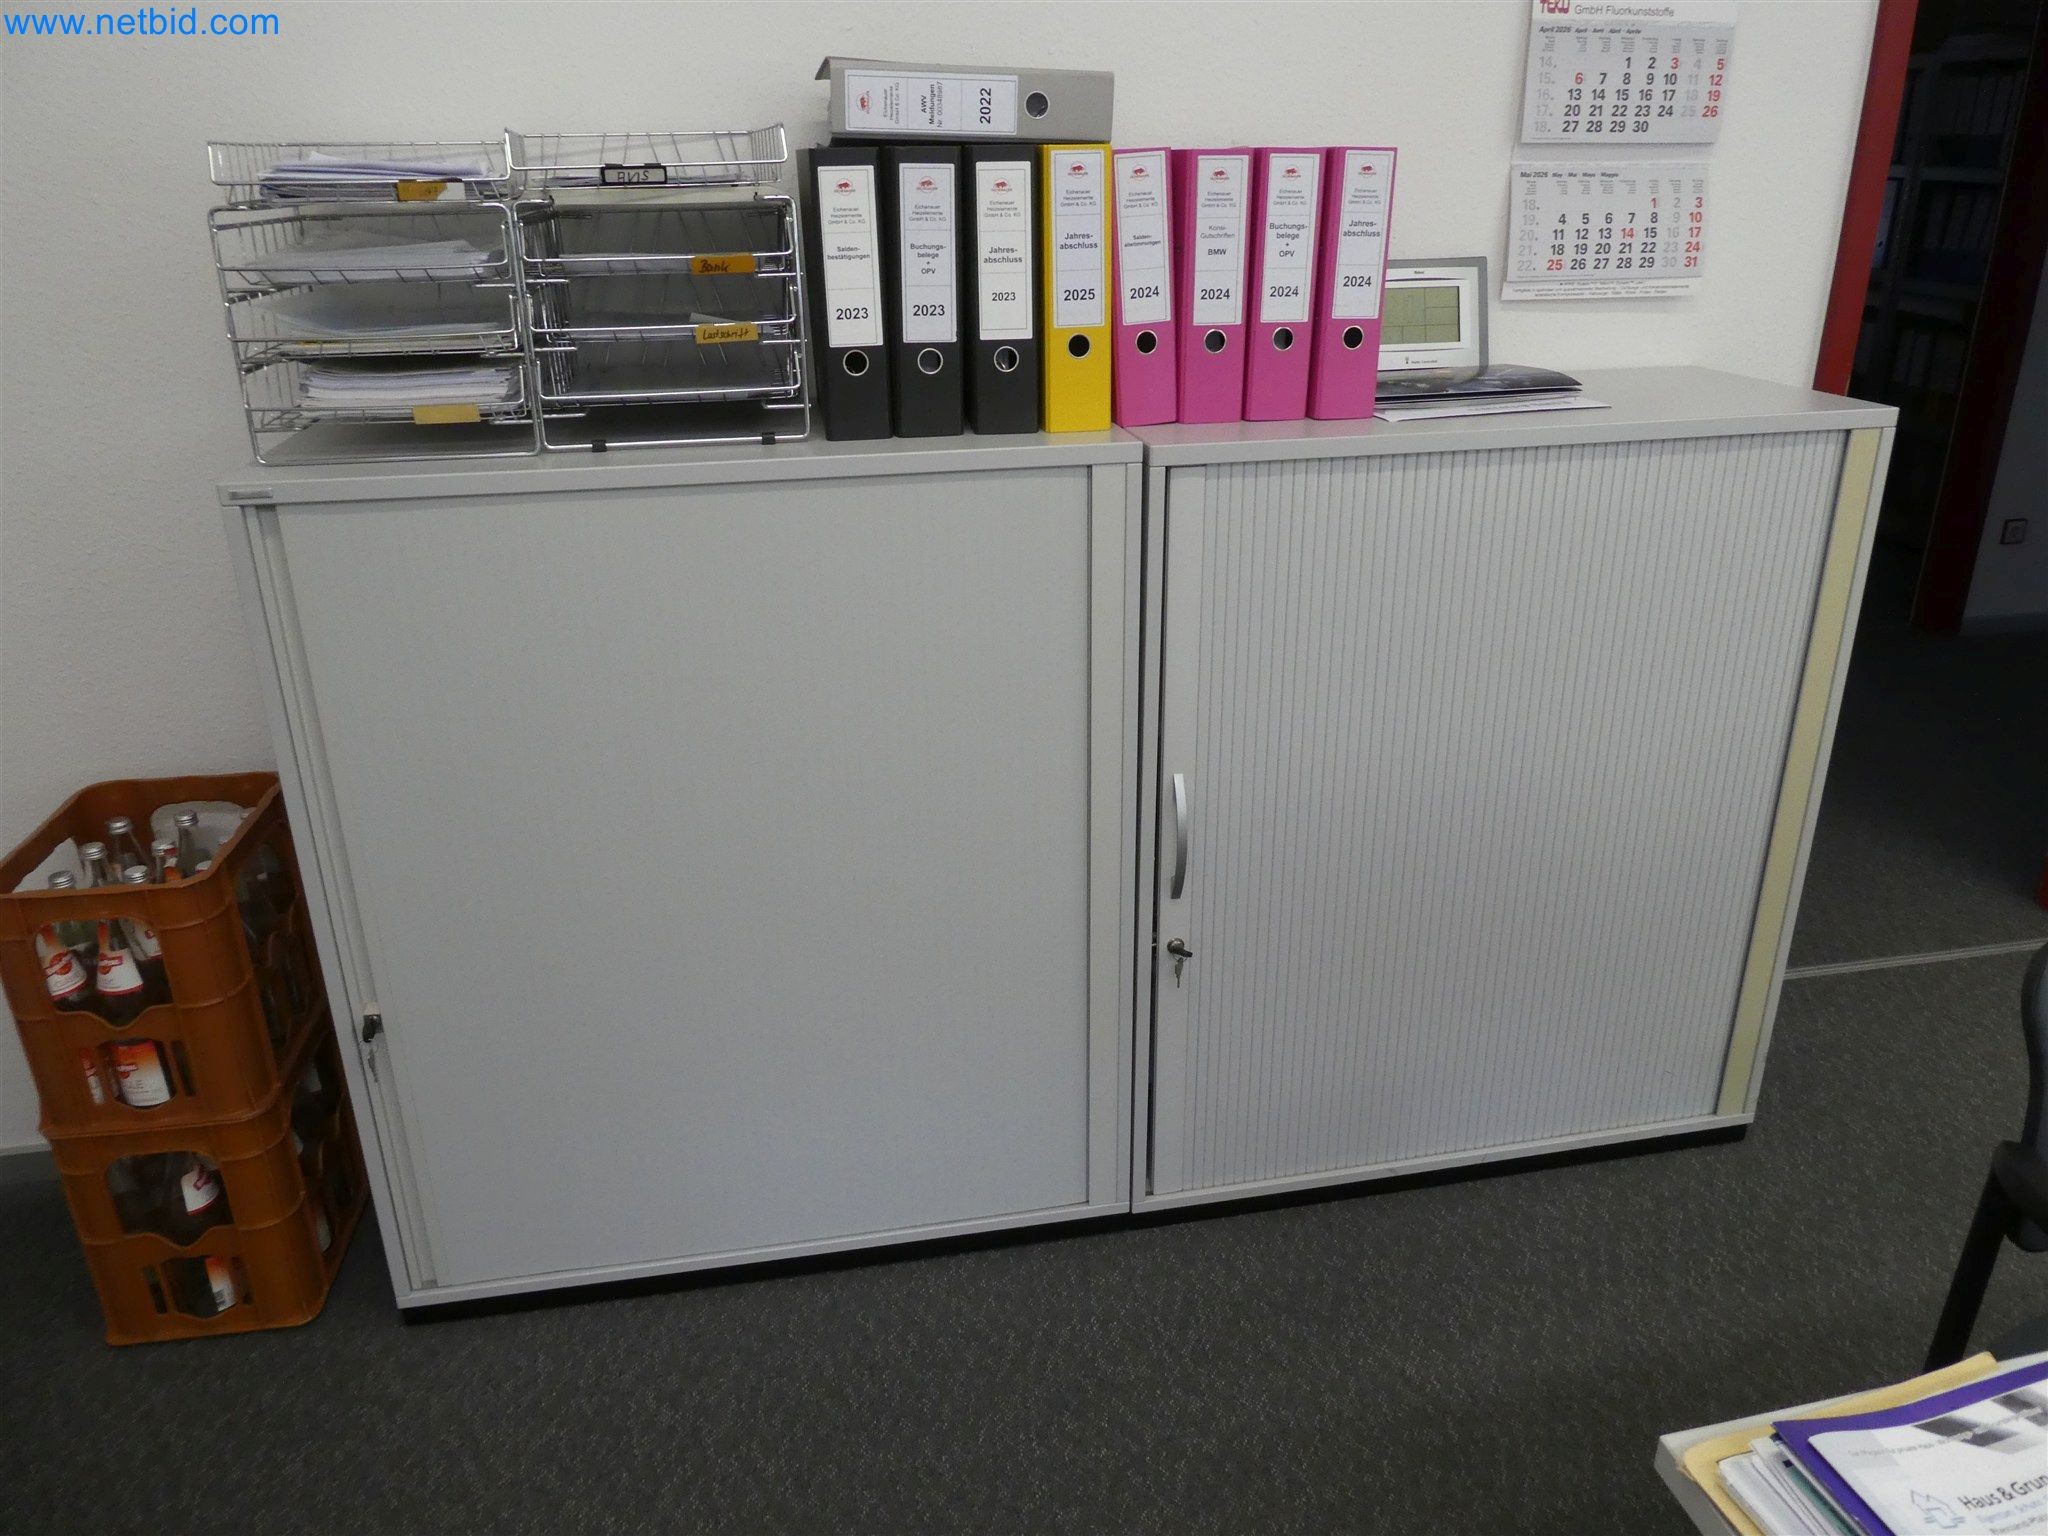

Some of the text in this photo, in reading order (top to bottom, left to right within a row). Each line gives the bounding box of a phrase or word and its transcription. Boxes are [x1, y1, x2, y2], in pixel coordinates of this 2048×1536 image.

[1575, 5, 1602, 15] GmbH
[1606, 5, 1674, 17] Fluorkunststoffe
[1625, 57, 1631, 69] 1
[1648, 58, 1656, 69] 2
[1671, 58, 1679, 69] 3
[1716, 58, 1724, 70] 5
[1575, 73, 1583, 85] 6
[1600, 73, 1607, 85] 7
[1623, 73, 1631, 85] 8
[1646, 74, 1654, 86] 9
[1664, 74, 1677, 86] 10
[1709, 74, 1723, 86] 12
[1568, 89, 1582, 101] 13
[1592, 89, 1606, 101] 14
[1615, 89, 1629, 101] 15
[1639, 89, 1653, 101] 16
[1662, 89, 1676, 101] 17
[1707, 90, 1721, 101] 19
[979, 88, 992, 124] 2022
[1564, 105, 1581, 117] 20
[1589, 105, 1603, 117] 21
[1611, 105, 1627, 117] 22
[1634, 106, 1650, 117] 23
[1657, 106, 1673, 117] 24
[1702, 106, 1719, 117] 26
[1562, 121, 1579, 132] 27
[1586, 121, 1602, 132] 28
[1609, 121, 1626, 132] 29
[1632, 121, 1649, 133] 30
[1651, 198, 1657, 208] 1
[1695, 197, 1702, 208] 3
[1349, 220, 1376, 228] Jahres-
[1558, 214, 1566, 224] 4
[1582, 213, 1589, 224] 5
[1605, 213, 1613, 224] 6
[1628, 213, 1636, 223] 7
[1651, 212, 1658, 223] 8
[1689, 212, 1703, 222] 10
[1065, 232, 1093, 240] Jahres-
[1276, 232, 1300, 240] belege
[1553, 229, 1564, 240] 11
[1575, 229, 1588, 240] 12
[1599, 229, 1612, 239] 13
[1621, 228, 1634, 239] 14
[1645, 228, 1657, 239] 15
[1689, 227, 1701, 238] 17
[910, 243, 946, 251] Buchungs-
[1060, 242, 1098, 250] abschluss
[1551, 245, 1564, 255] 18
[1574, 244, 1587, 255] 19
[1595, 244, 1610, 254] 20
[1619, 243, 1632, 254] 21
[1641, 243, 1657, 254] 22
[1685, 242, 1700, 253] 24
[827, 253, 870, 261] bestätigungen
[1547, 260, 1563, 270] 25
[1571, 259, 1586, 270] 26
[1594, 259, 1609, 269] 27
[1617, 258, 1632, 269] 28
[1639, 257, 1655, 268] 29
[1684, 256, 1698, 267] 31
[699, 260, 729, 273] Bank
[1343, 276, 1371, 287] 2024
[992, 292, 1016, 301] 2023
[1064, 289, 1095, 301] 2025
[1130, 286, 1160, 299] 2024
[1200, 289, 1230, 300] 2024
[1270, 286, 1299, 297] 2024
[836, 308, 869, 320] 2023
[913, 305, 945, 316] 2023
[702, 329, 749, 340] Lastschrift
[1958, 1490, 2000, 1511] Haus
[2000, 1487, 2014, 1500] &
